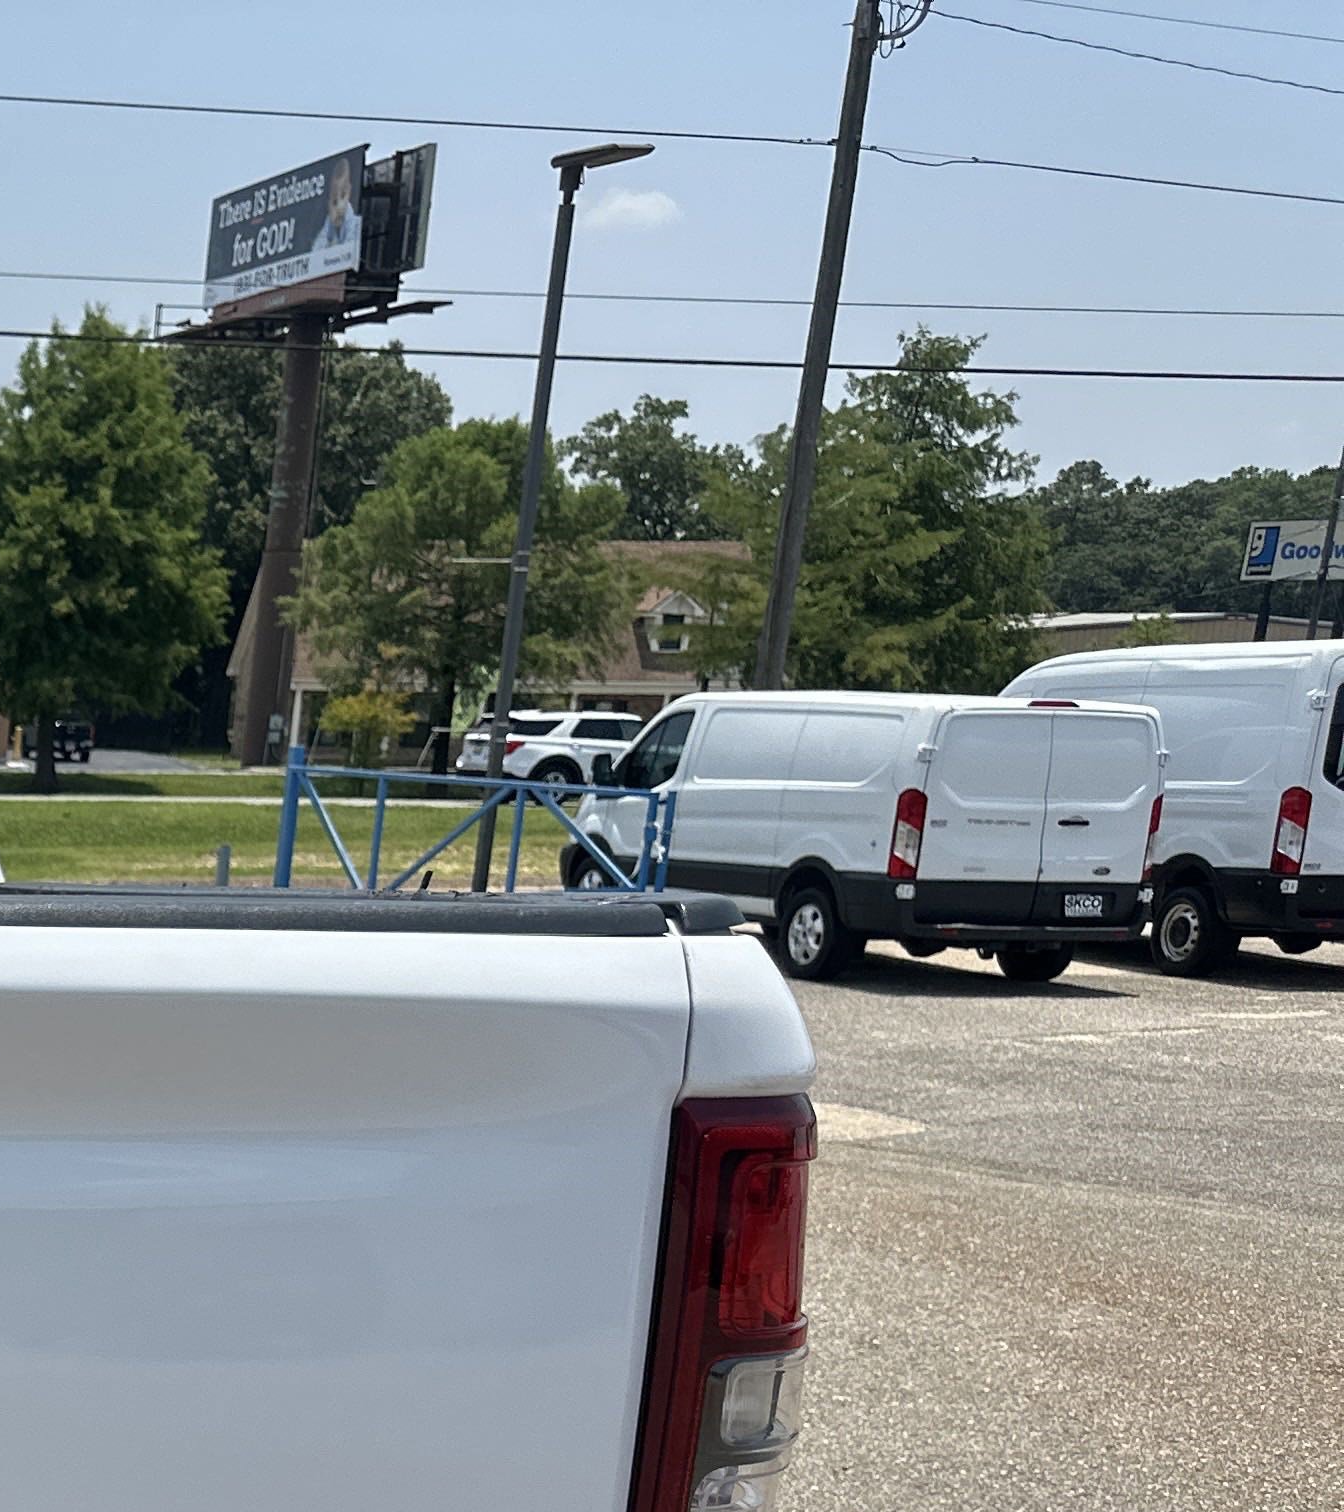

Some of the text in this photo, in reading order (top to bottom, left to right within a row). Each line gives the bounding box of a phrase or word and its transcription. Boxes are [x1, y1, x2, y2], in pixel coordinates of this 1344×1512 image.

[218, 173, 325, 229] There IS Evidence
[232, 217, 295, 267] for GOD!
